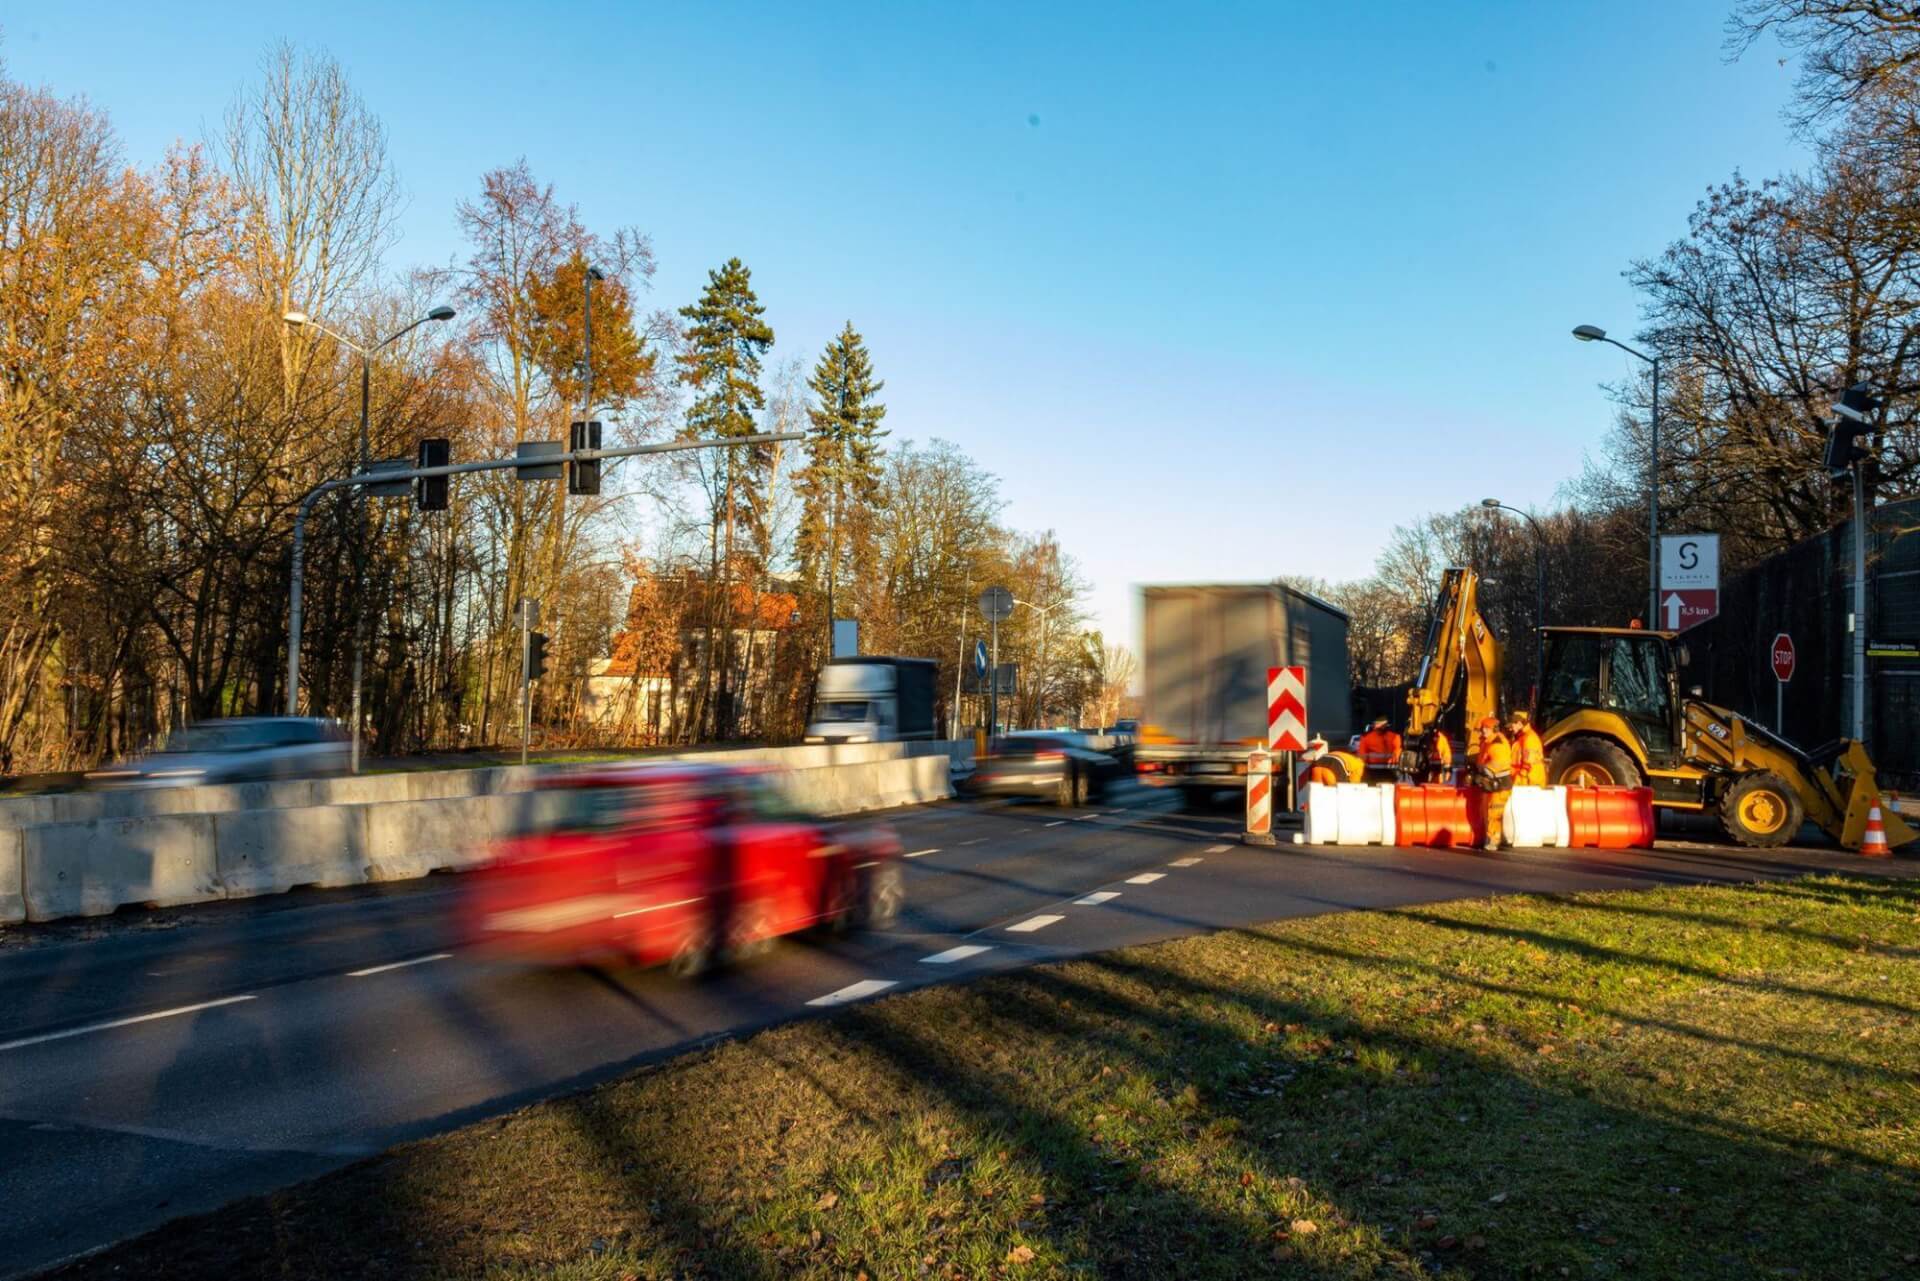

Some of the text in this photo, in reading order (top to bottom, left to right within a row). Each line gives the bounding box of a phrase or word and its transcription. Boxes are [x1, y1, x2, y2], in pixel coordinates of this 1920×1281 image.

[1679, 542, 1698, 570] S
[1696, 606, 1709, 615] km
[1775, 650, 1792, 664] STOP
